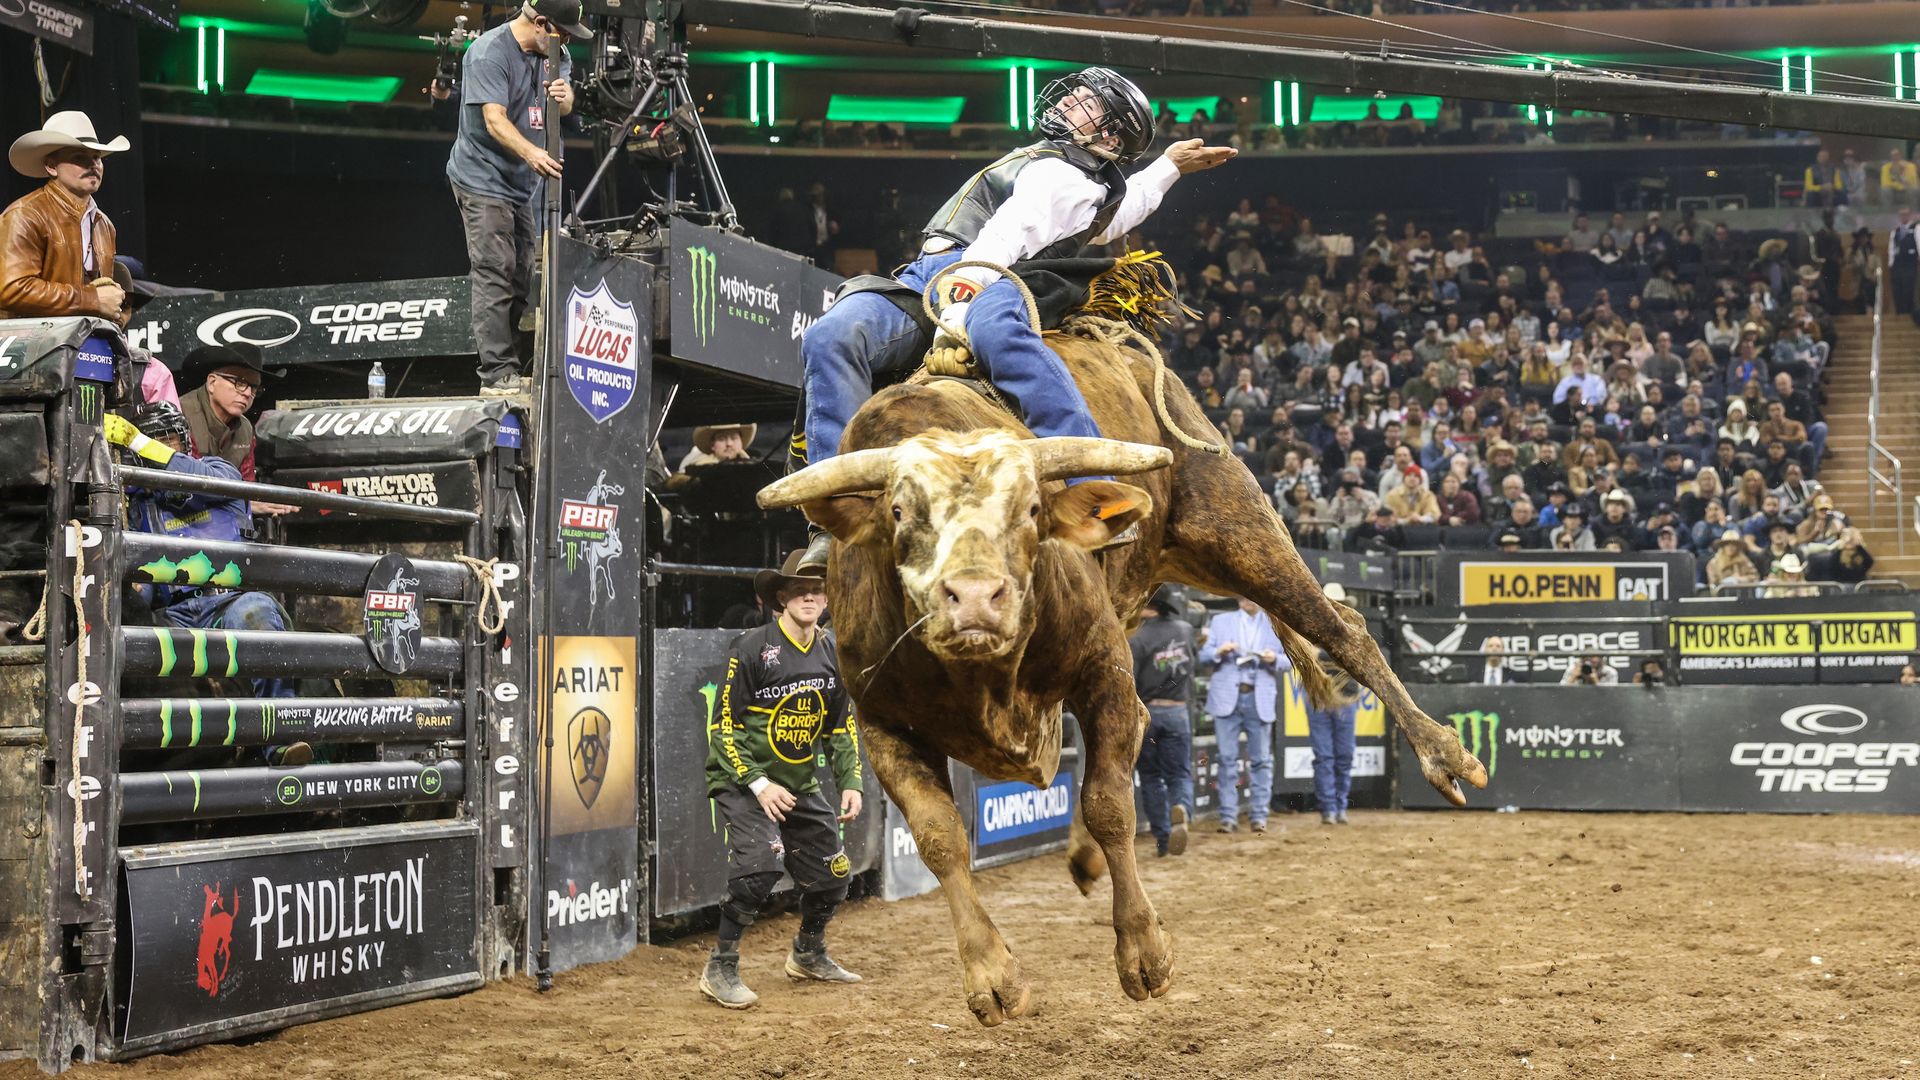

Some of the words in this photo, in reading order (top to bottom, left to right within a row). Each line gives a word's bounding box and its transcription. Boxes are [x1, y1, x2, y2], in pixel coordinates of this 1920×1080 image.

[28, 0, 83, 30] COOPER
[35, 14, 74, 38] TIRES
[309, 298, 449, 325] COOPER
[728, 305, 771, 326] ENERGY
[326, 320, 426, 345] TIRES
[574, 325, 632, 364] LUCAS
[78, 351, 91, 362] CBS
[90, 353, 113, 365] SPORTS
[568, 364, 585, 382] OIL
[586, 366, 632, 391] PRODUCTS
[592, 390, 610, 408] INC.
[292, 410, 401, 436] LUCAS
[401, 405, 467, 436] OIL.
[342, 473, 436, 496] TRACTOR
[563, 505, 615, 528] PBR
[368, 593, 414, 610] PBR
[1617, 577, 1663, 601] CAT
[1537, 631, 1640, 651] FORCE
[1684, 623, 1776, 648] MORGAN
[1784, 623, 1800, 646] &
[1680, 656, 1746, 670] AMERICA'S
[1746, 656, 1799, 669] LARGEST
[1800, 655, 1847, 668] INURY
[1847, 655, 1876, 667] LAW
[553, 667, 625, 694] ARIAT
[314, 706, 369, 728] BUCKING
[371, 704, 413, 725] BATTLE
[424, 716, 452, 727] ARIAT
[777, 714, 820, 728] BORDR
[1730, 742, 1920, 767] COOPER
[284, 785, 296, 796] 20
[306, 780, 338, 796] NEW
[344, 777, 382, 793] YORK
[387, 775, 418, 791] CITY
[1755, 768, 1892, 793] TIRES
[983, 789, 1035, 833] CAMPING
[1033, 784, 1070, 820] WORLD
[249, 857, 424, 961] PENDLETON
[547, 879, 630, 930] Priefert
[292, 940, 386, 984] WHISKY
